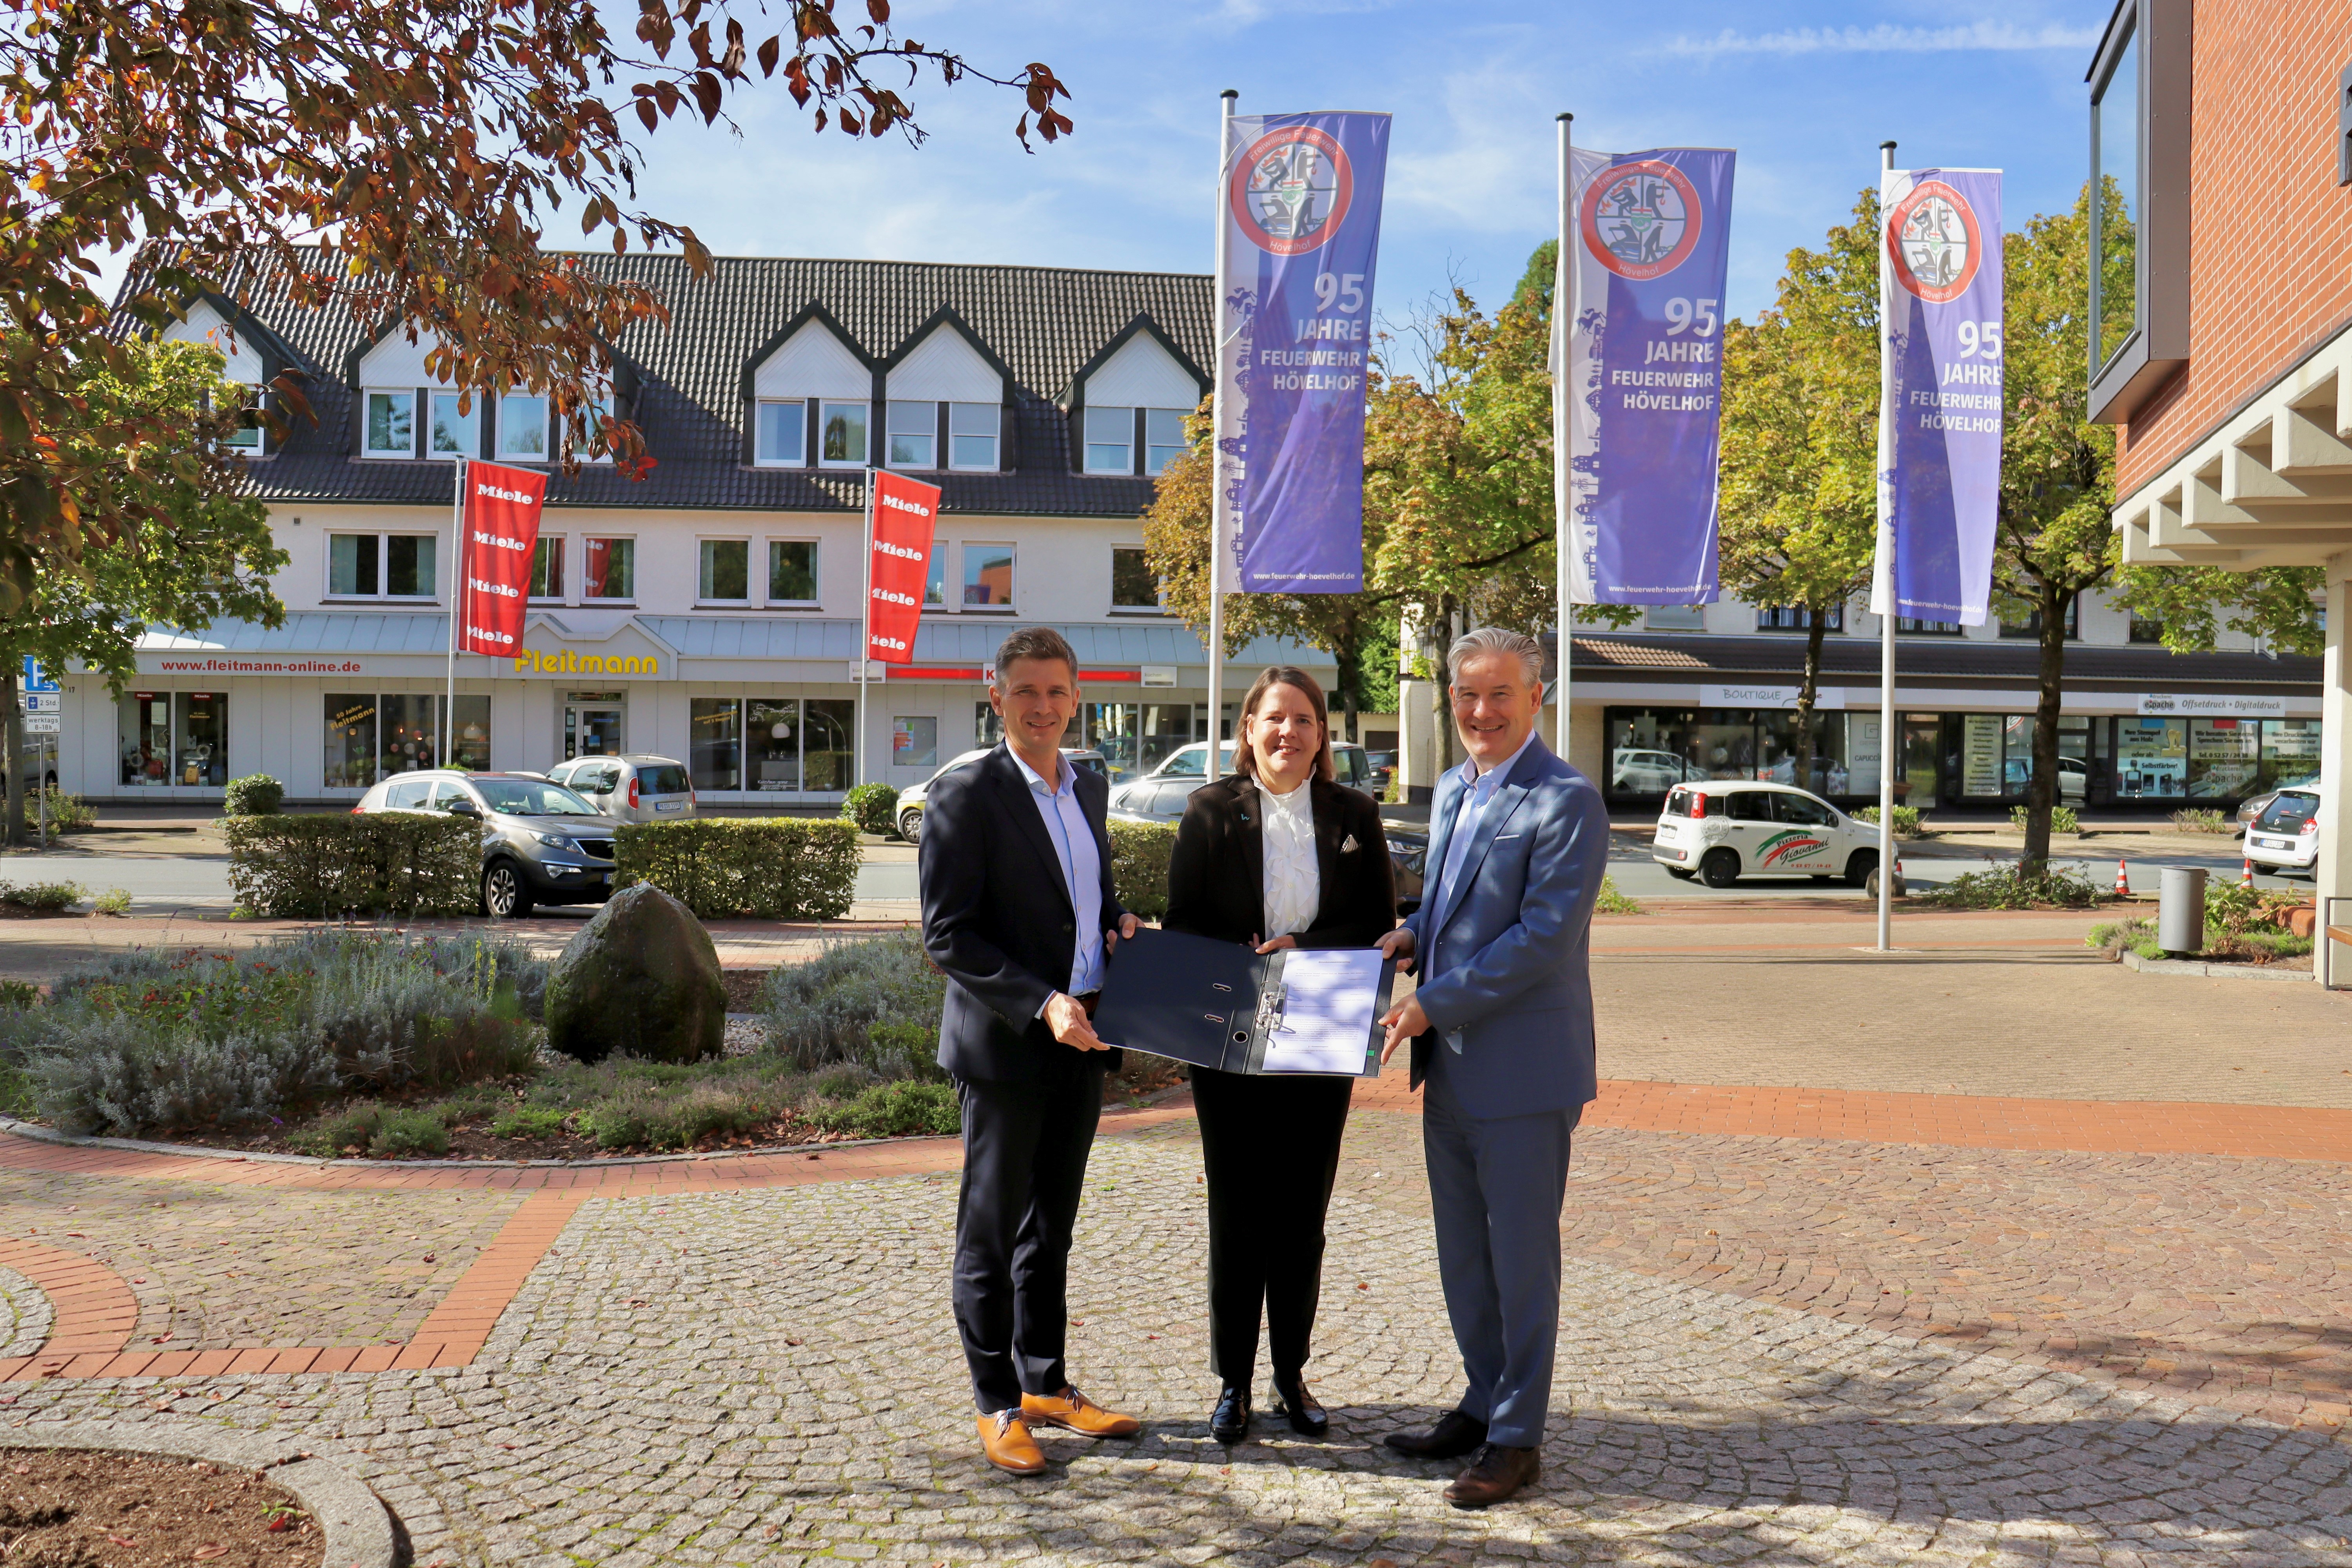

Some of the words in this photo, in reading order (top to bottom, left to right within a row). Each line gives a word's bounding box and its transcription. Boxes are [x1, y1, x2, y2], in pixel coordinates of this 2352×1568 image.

[1248, 132, 1291, 160] Freiwillige
[1294, 129, 1339, 156] Feuerwehr
[1596, 165, 1639, 189] Freiwillige
[1643, 163, 1686, 189] Feuerwehr
[1901, 185, 1932, 212] Freiwillige
[1933, 184, 1966, 211] Feuerwehr
[1269, 240, 1310, 252] Hövelhof
[1618, 264, 1659, 276] Hövelhof
[1315, 272, 1365, 313] 95
[1921, 288, 1953, 299] Hövelhof
[1664, 297, 1717, 337] 95
[1295, 319, 1363, 344] JAHRE
[1958, 320, 2002, 359] 95
[1261, 350, 1361, 367] FEUERWEHR
[1644, 341, 1715, 365] JAHRE
[1273, 370, 1360, 390] HÖVELHOF
[1612, 370, 1714, 388] FEUERWEHR
[1942, 363, 2001, 386] JAHRE
[1624, 390, 1714, 411] HÖVELHOF
[1910, 390, 2001, 410] FEUERWEHR
[1920, 411, 2001, 433] HÖVELHOF
[477, 484, 533, 505] Miele
[882, 494, 929, 517] Miele
[473, 530, 525, 551] Miele
[874, 540, 922, 561] Miele
[1253, 572, 1355, 581] www.feuerwehr-hoevelhof.de
[468, 577, 519, 597] Miele
[1608, 584, 1711, 593] www.feuerwehr-hoevelhof.de
[1897, 599, 1983, 613] www.feuerwehr-hoevelhof.de
[467, 625, 514, 644] Miele
[871, 633, 906, 650] iele
[162, 660, 361, 671] www.fleitmann-online.de
[515, 648, 658, 674] Fleitmann
[1723, 689, 1781, 700] BOUTIQUE
[346, 705, 362, 715] Jahre
[2182, 699, 2226, 710] Offsetdruck
[2235, 701, 2281, 711] Digitaldruck
[330, 708, 375, 731] Fleitmann
[1777, 834, 1808, 847] Pizzeria
[1780, 837, 1829, 865] Giovanni
